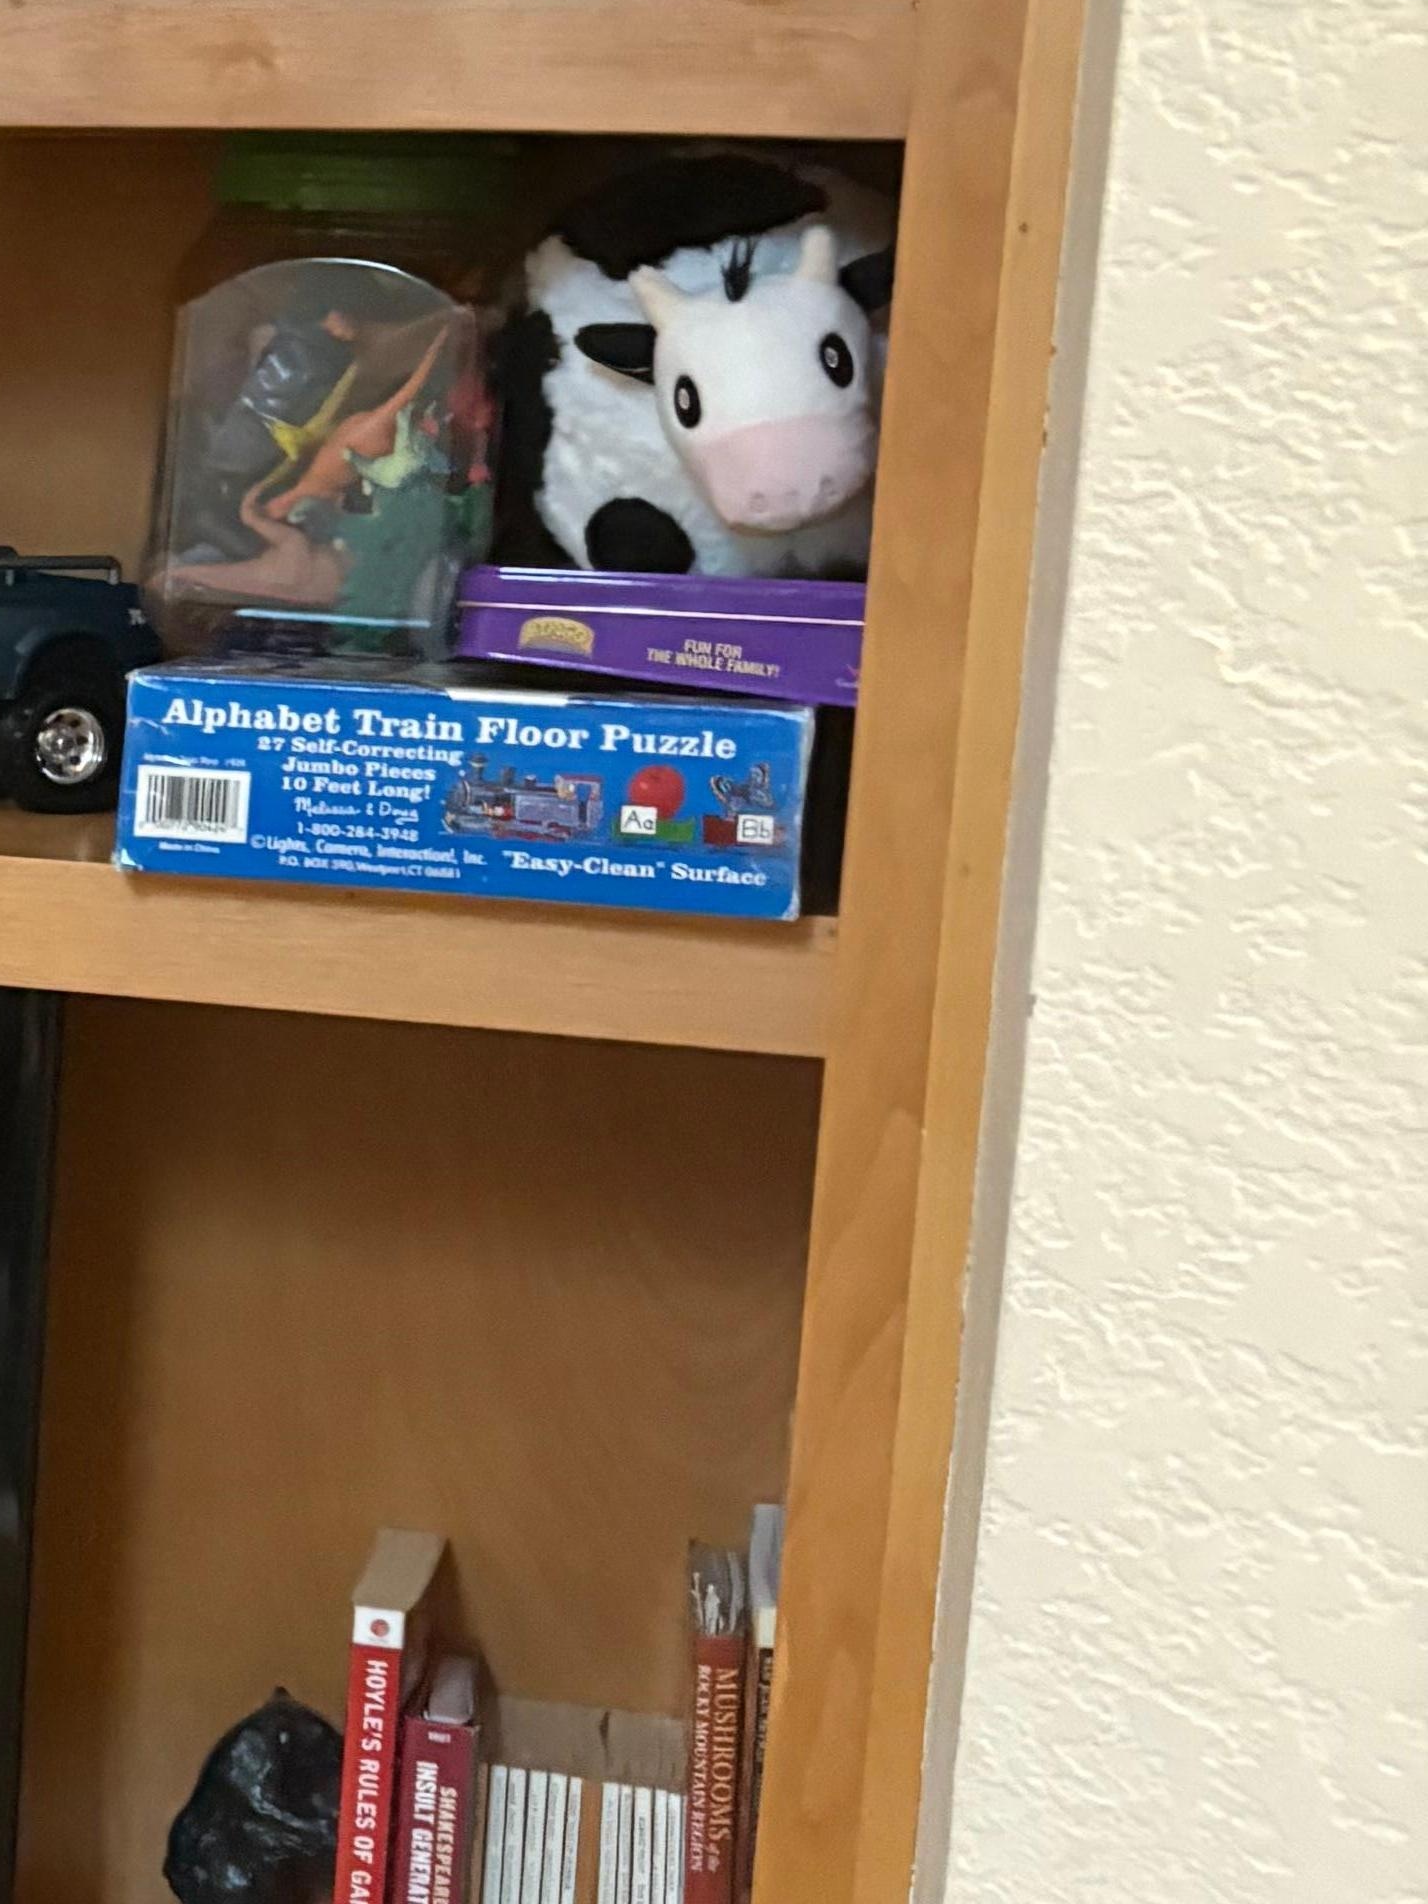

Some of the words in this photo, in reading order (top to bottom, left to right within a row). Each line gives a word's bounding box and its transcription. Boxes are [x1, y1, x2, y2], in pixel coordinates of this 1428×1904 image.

[647, 648, 673, 664] THE
[675, 652, 723, 671] WHOLE
[726, 657, 780, 678] FAMILY!
[684, 639, 711, 654] FUN
[716, 642, 742, 658] FOR
[162, 698, 342, 738] Alphabet
[353, 708, 464, 744] Train
[476, 717, 589, 752] Floor
[603, 725, 737, 760] Puzzle
[257, 737, 283, 751] 27
[290, 738, 464, 766] Self-Correcting
[282, 756, 359, 776] Jumbo
[365, 761, 436, 782] Pieces
[282, 777, 307, 791] 10
[312, 778, 362, 795] Feet
[367, 782, 431, 802] Long!
[296, 823, 420, 842] 1-800-284-3948
[624, 808, 655, 831] Aa
[503, 850, 665, 878] "Easy-Clean"
[671, 863, 767, 886] Surface
[361, 1659, 389, 1752] HOYLE'S
[710, 1667, 740, 1842] MUSHROOMS
[355, 1757, 382, 1829] RULES
[410, 1760, 439, 1825] INSULT
[352, 1834, 376, 1863] OF
